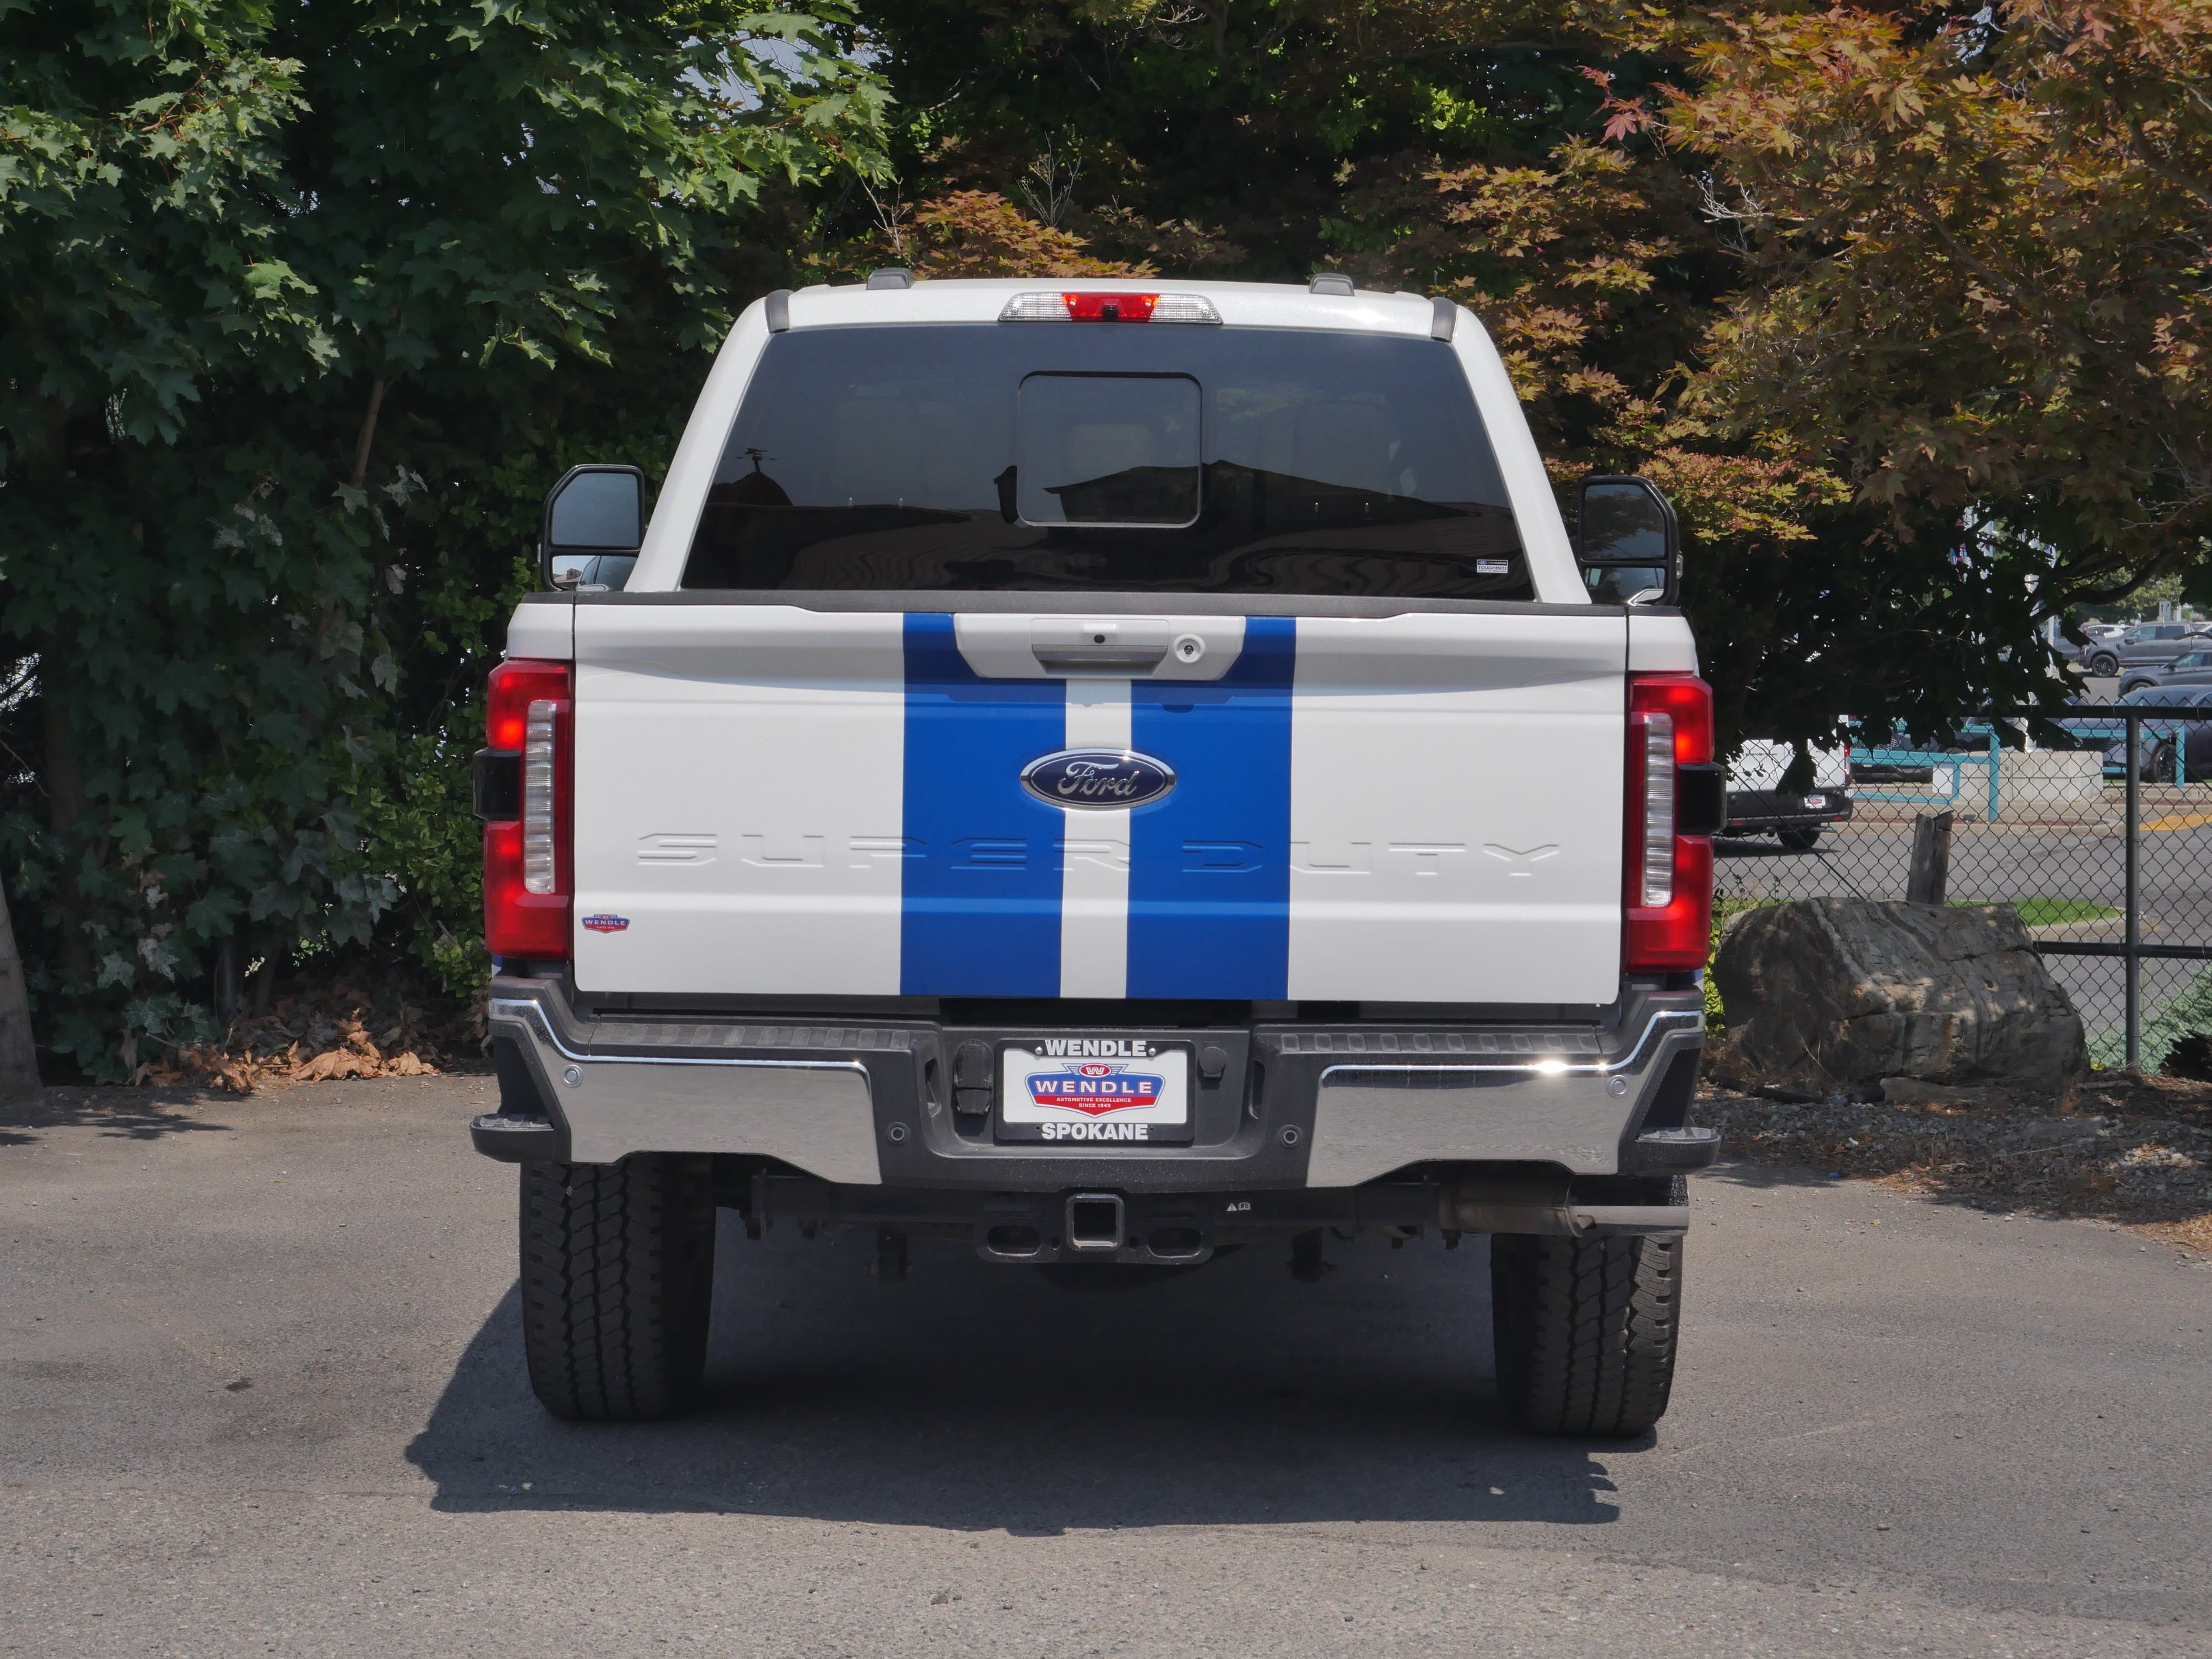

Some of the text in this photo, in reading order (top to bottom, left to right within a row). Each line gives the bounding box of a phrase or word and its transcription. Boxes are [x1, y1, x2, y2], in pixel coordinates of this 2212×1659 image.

[1057, 761, 1140, 796] Ford
[638, 832, 1560, 876] SUPER DUTY
[1044, 1040, 1147, 1057] WENDLE
[1035, 1080, 1152, 1094] WENDLE
[1041, 1122, 1148, 1140] SPOKANE
